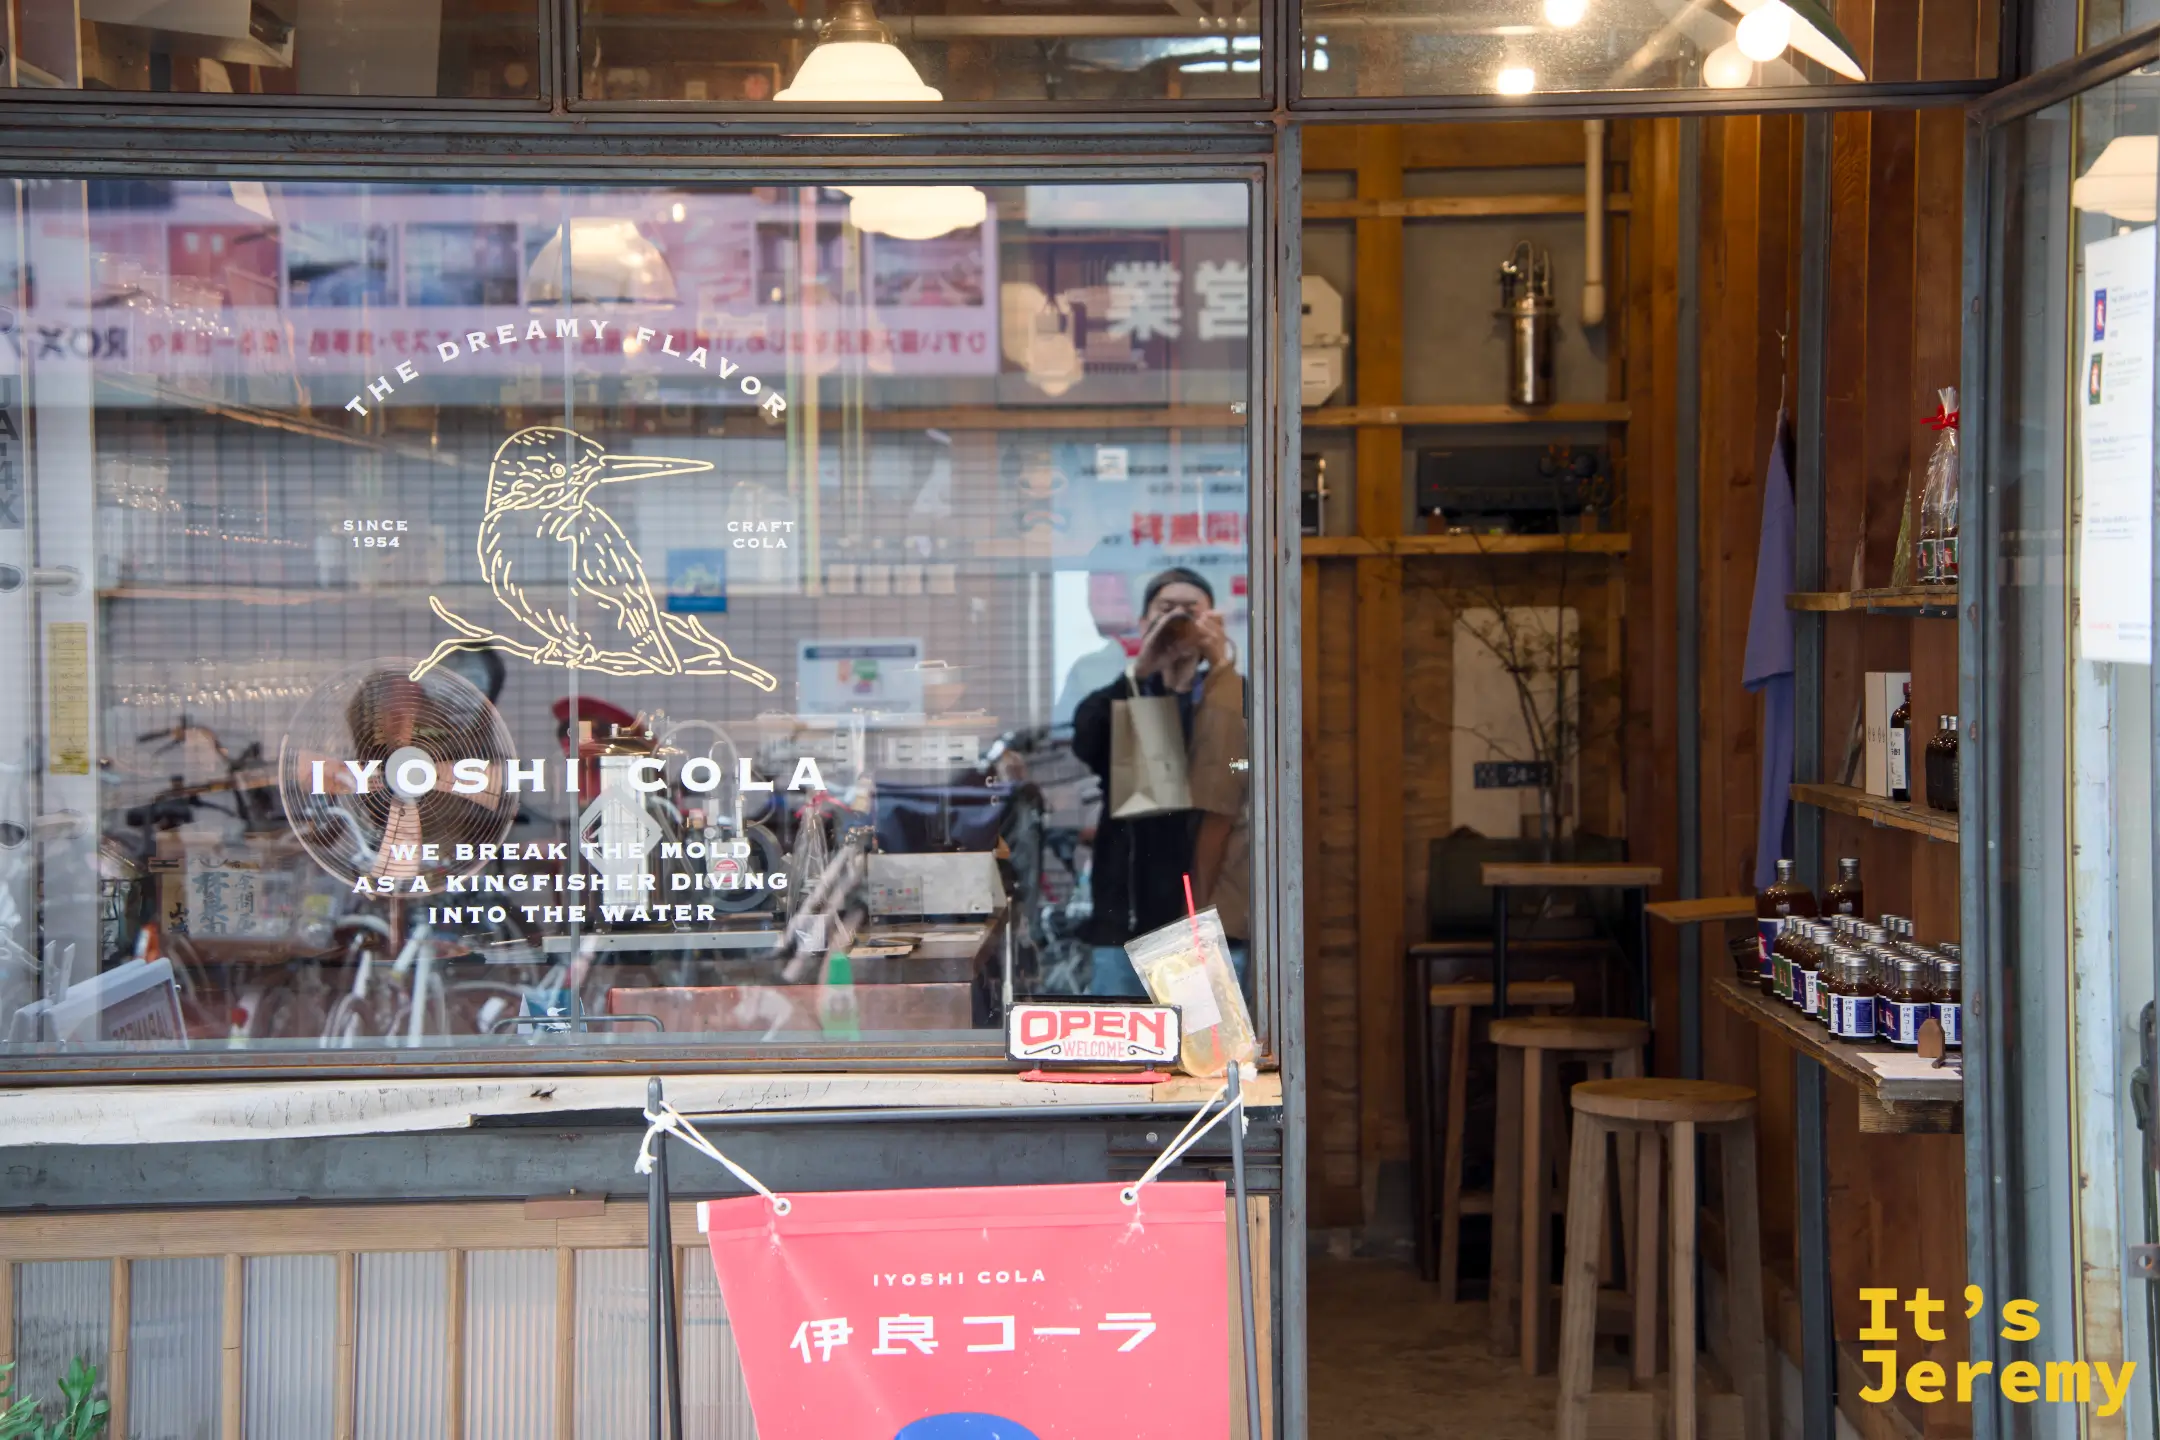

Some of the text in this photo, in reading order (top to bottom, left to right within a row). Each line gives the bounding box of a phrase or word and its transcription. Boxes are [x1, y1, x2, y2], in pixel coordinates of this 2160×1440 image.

[345, 359, 419, 417] THE
[436, 318, 609, 363] DREAMY
[636, 325, 787, 418] FLAVOR
[343, 519, 408, 532] SINCE
[726, 520, 795, 533] CRAFT
[352, 536, 400, 548] 1954
[732, 535, 788, 549] COLA
[311, 756, 827, 796] IYOSHI COLA
[389, 841, 751, 862] WE BREAK THE MOLD
[352, 871, 789, 894] AS A KINGFISHER DIVING
[428, 903, 716, 924] INTO THE WATER
[1020, 1010, 1167, 1048] OPEN
[1062, 1040, 1126, 1058] WELCOME
[873, 1268, 1046, 1287] IYOSHI COLA
[789, 1312, 1158, 1364] 伊良コーラ
